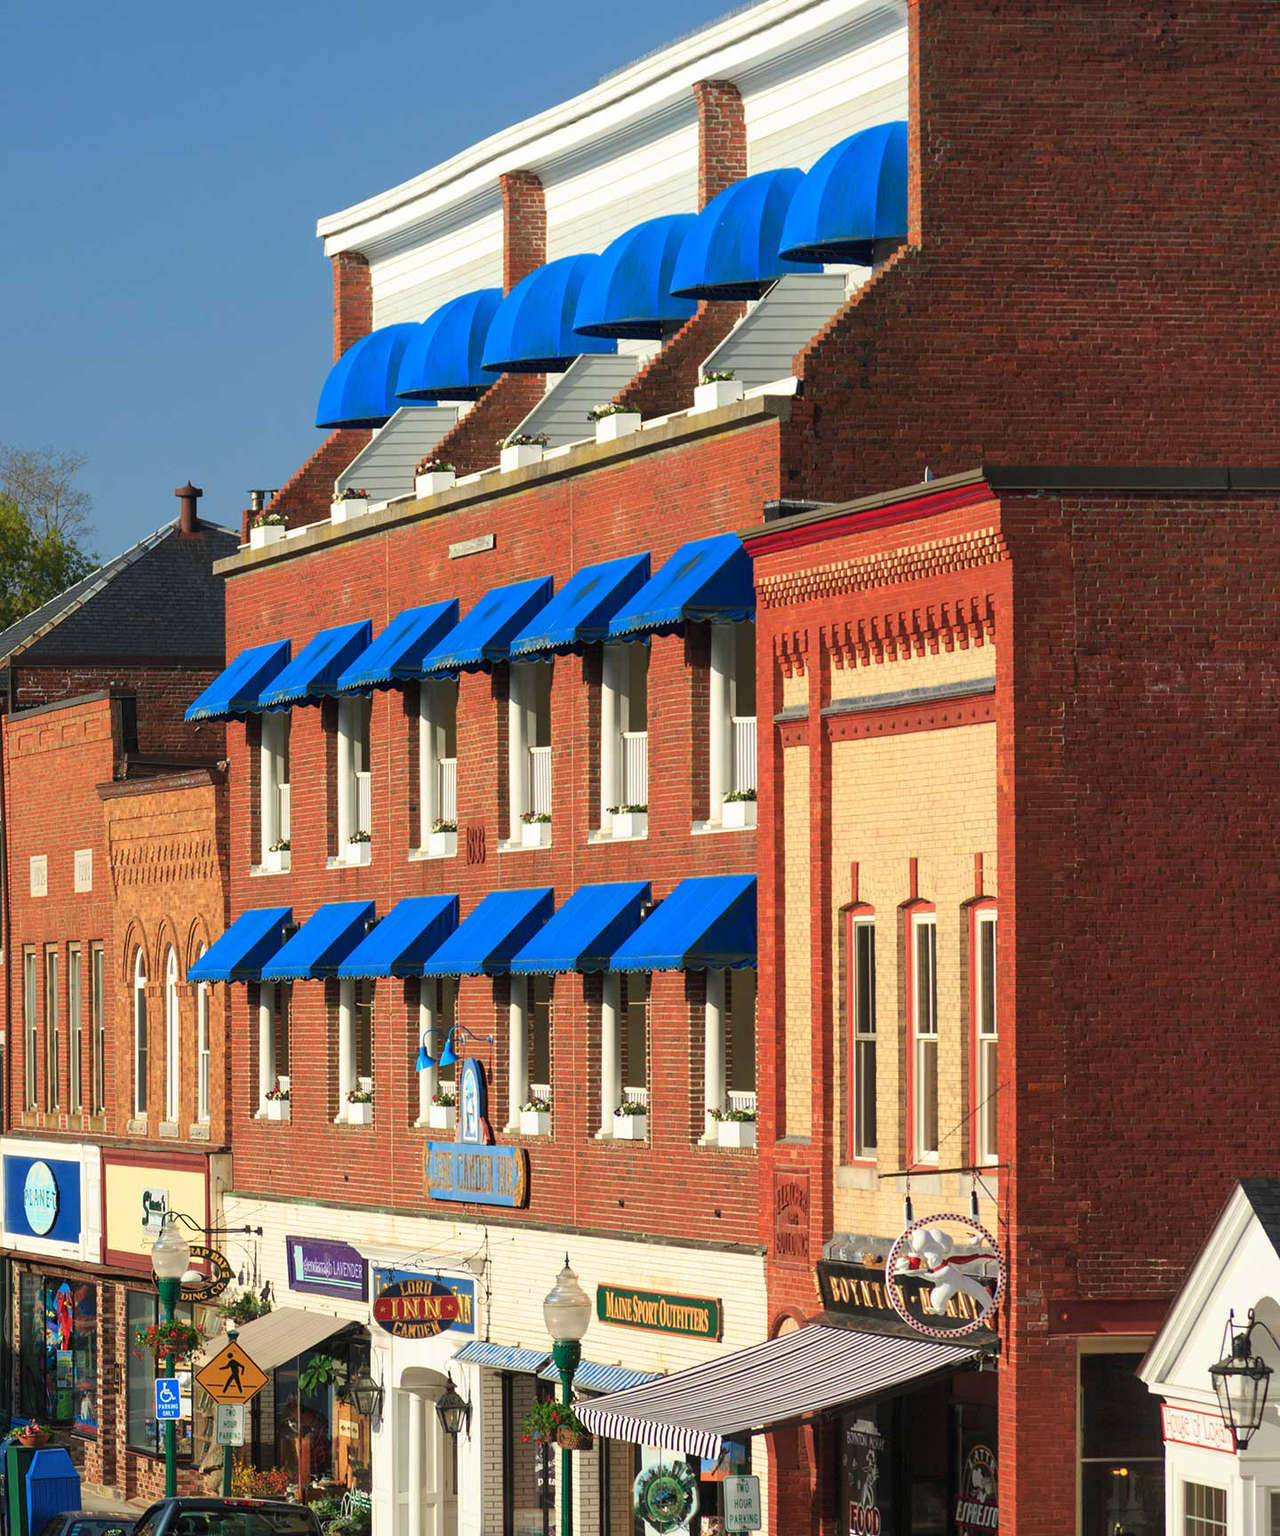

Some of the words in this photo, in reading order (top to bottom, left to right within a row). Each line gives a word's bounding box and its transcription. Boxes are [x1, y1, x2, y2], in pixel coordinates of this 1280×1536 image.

[210, 1252, 229, 1269] BAY
[333, 1260, 363, 1279] LAVENDER
[399, 1279, 433, 1296] LORD
[391, 1298, 442, 1320] INN
[605, 1291, 632, 1322] MAINE
[632, 1295, 659, 1326] SPORT
[659, 1298, 709, 1333] OUTFITTERS
[392, 1320, 442, 1338] CAMDEN
[736, 1482, 750, 1493] TWO
[733, 1498, 753, 1509] HOUR
[729, 1513, 759, 1524] PARKING
[849, 1500, 880, 1536] FOOD
[955, 1501, 998, 1529] ESPRESSO
